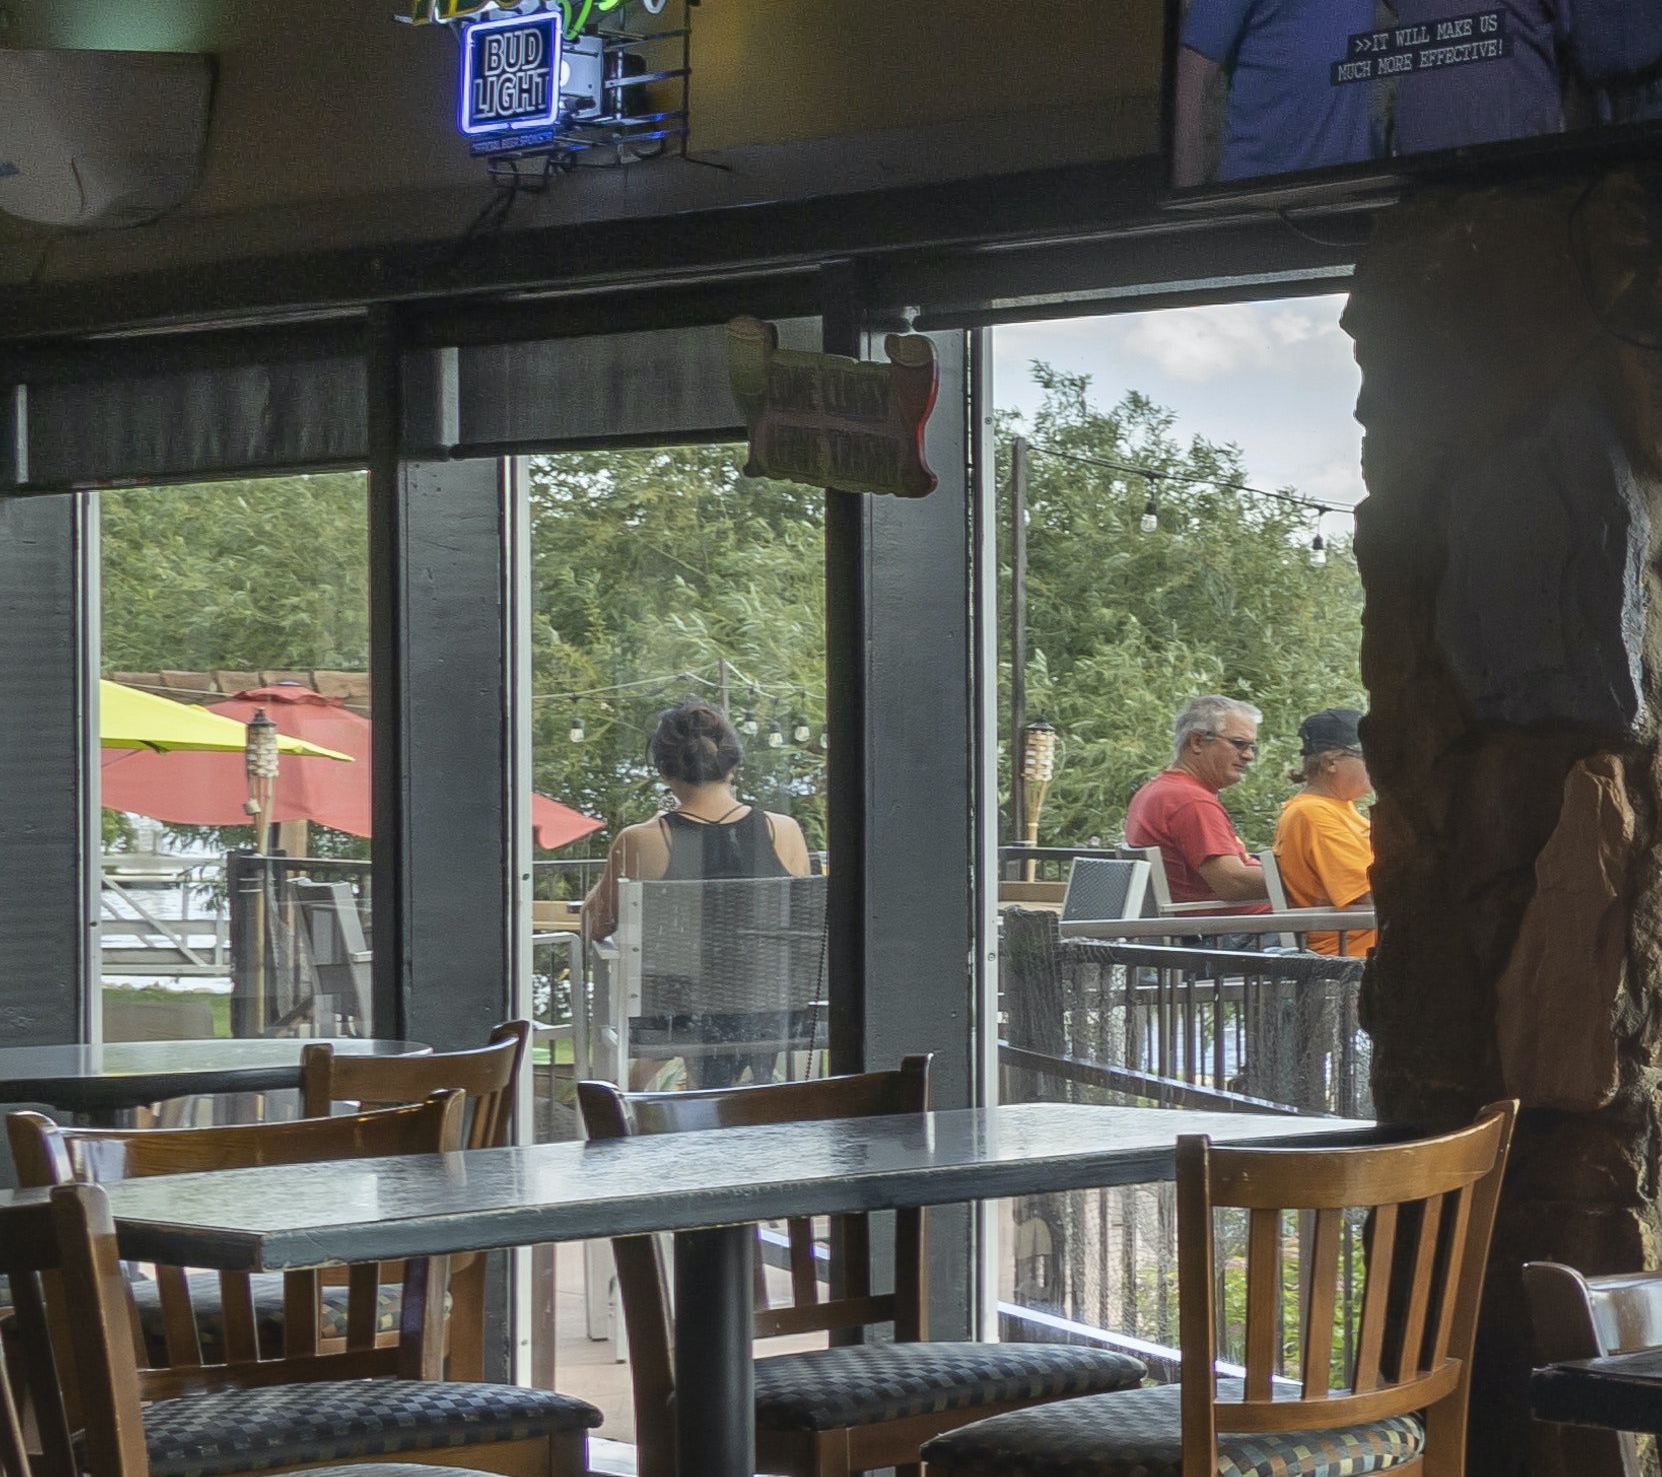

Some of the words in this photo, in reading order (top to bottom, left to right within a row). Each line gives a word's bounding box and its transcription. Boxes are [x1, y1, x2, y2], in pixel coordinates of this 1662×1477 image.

[484, 28, 543, 77] BUD
[1395, 25, 1430, 48] WILL
[1436, 18, 1473, 42] MAKE
[1479, 14, 1498, 33] US
[1337, 59, 1371, 82] MUCH
[1377, 53, 1413, 75] MORE
[1419, 38, 1504, 69] EFFECTIVE!
[472, 69, 550, 119] LIGHT
